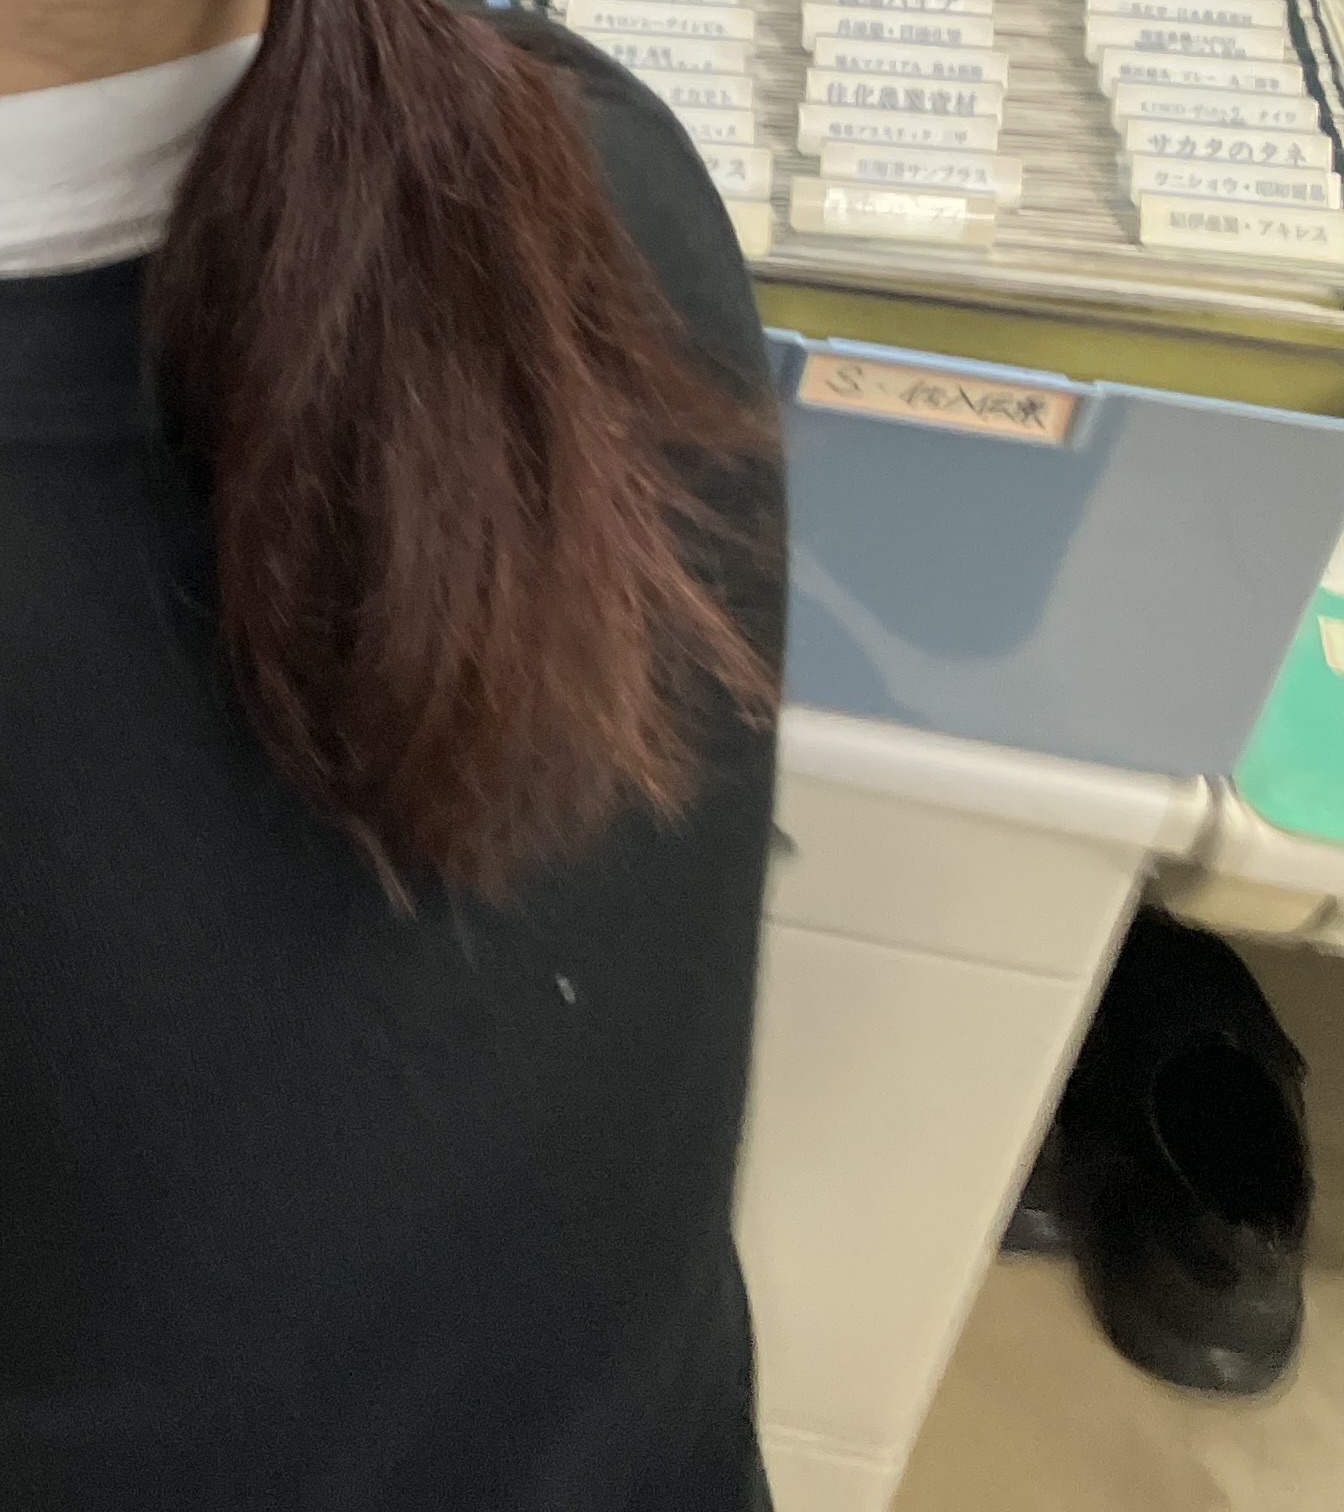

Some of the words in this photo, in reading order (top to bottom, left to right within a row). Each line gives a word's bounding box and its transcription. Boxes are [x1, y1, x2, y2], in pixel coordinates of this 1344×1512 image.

[1147, 132, 1308, 168] サカタのタネ
